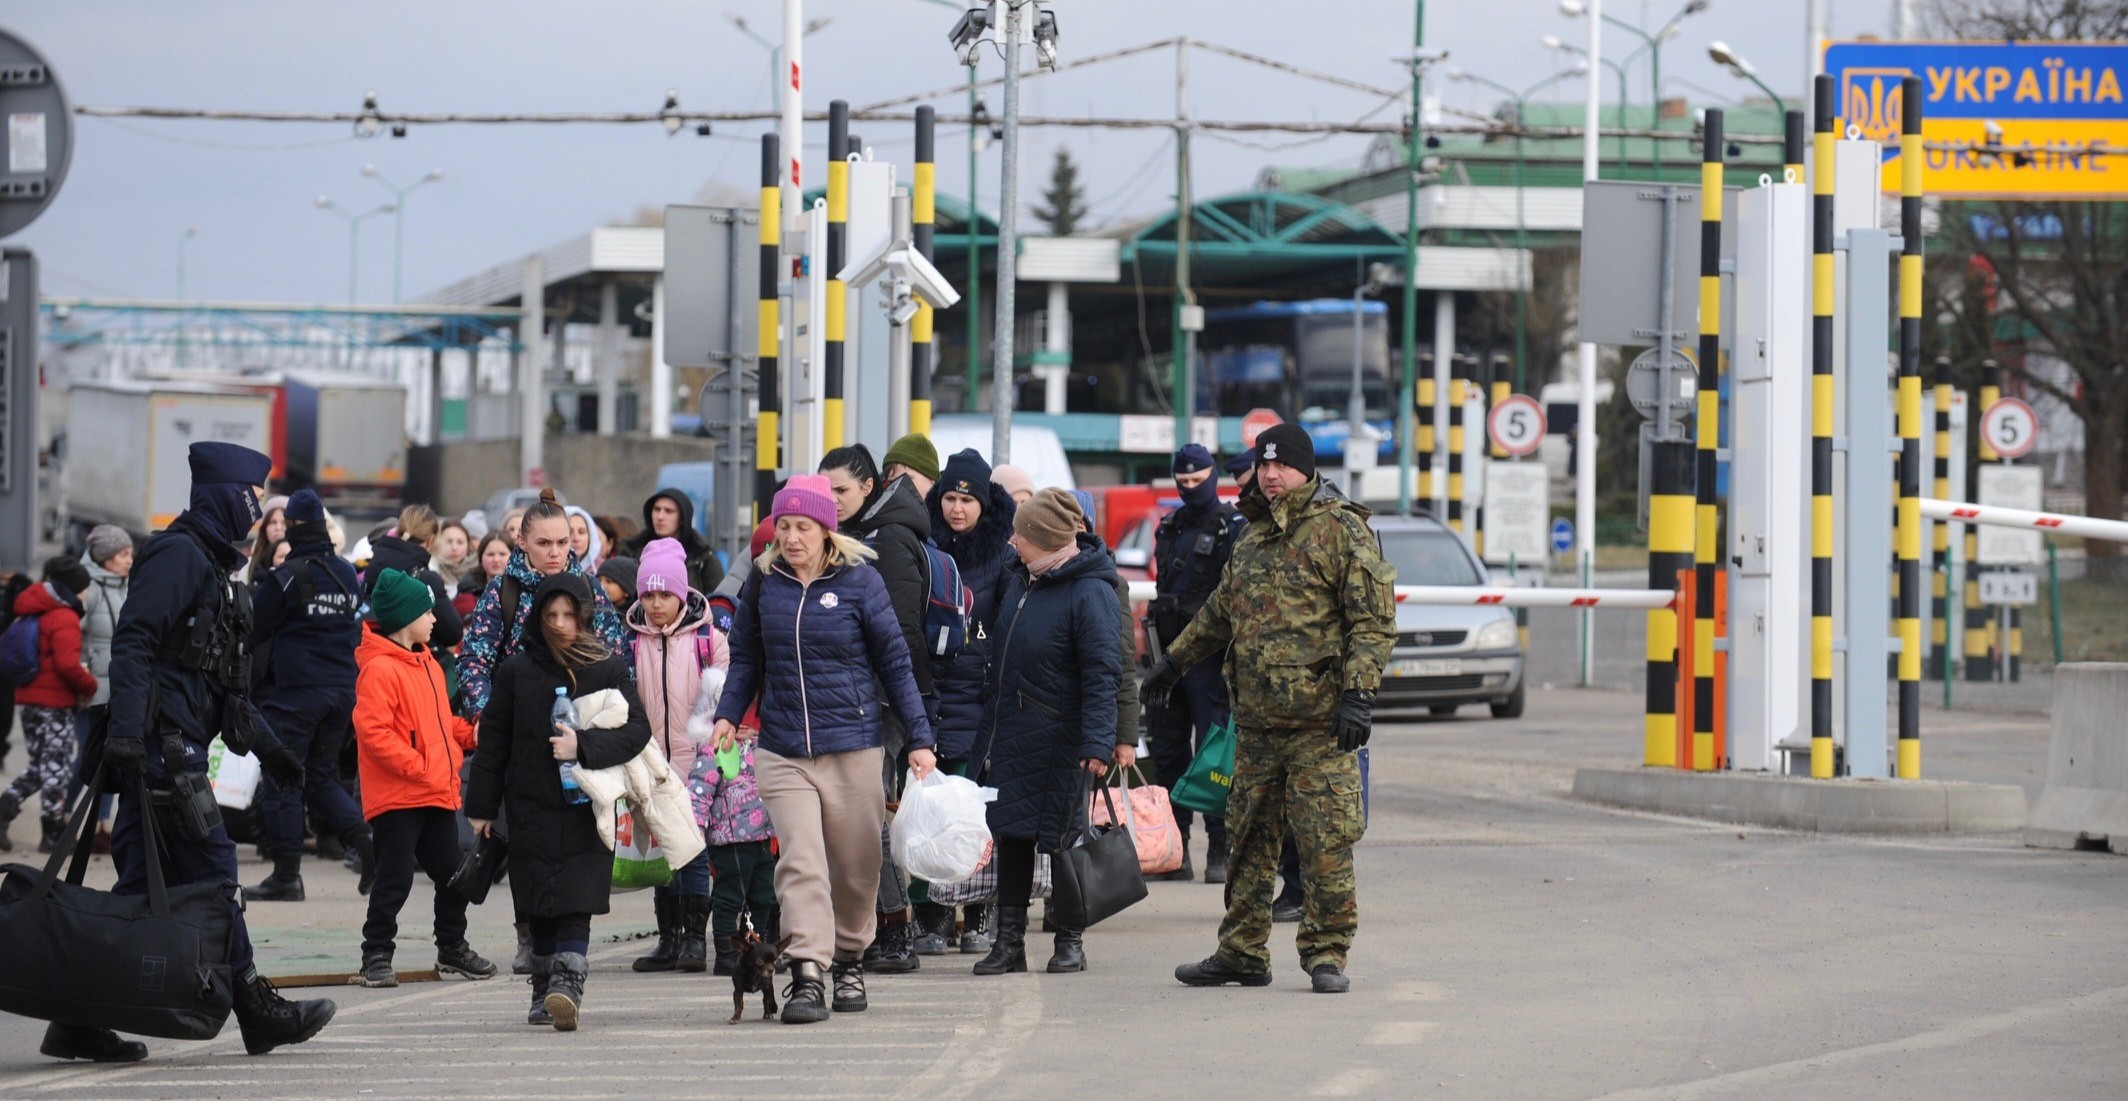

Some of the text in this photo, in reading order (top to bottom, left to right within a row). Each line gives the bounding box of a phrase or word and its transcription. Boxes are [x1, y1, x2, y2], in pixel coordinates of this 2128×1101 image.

[1926, 58, 2123, 103] УКРАЇНА
[1508, 411, 1526, 439] 5
[2001, 416, 2018, 444] 5
[307, 593, 358, 615] POLICA
